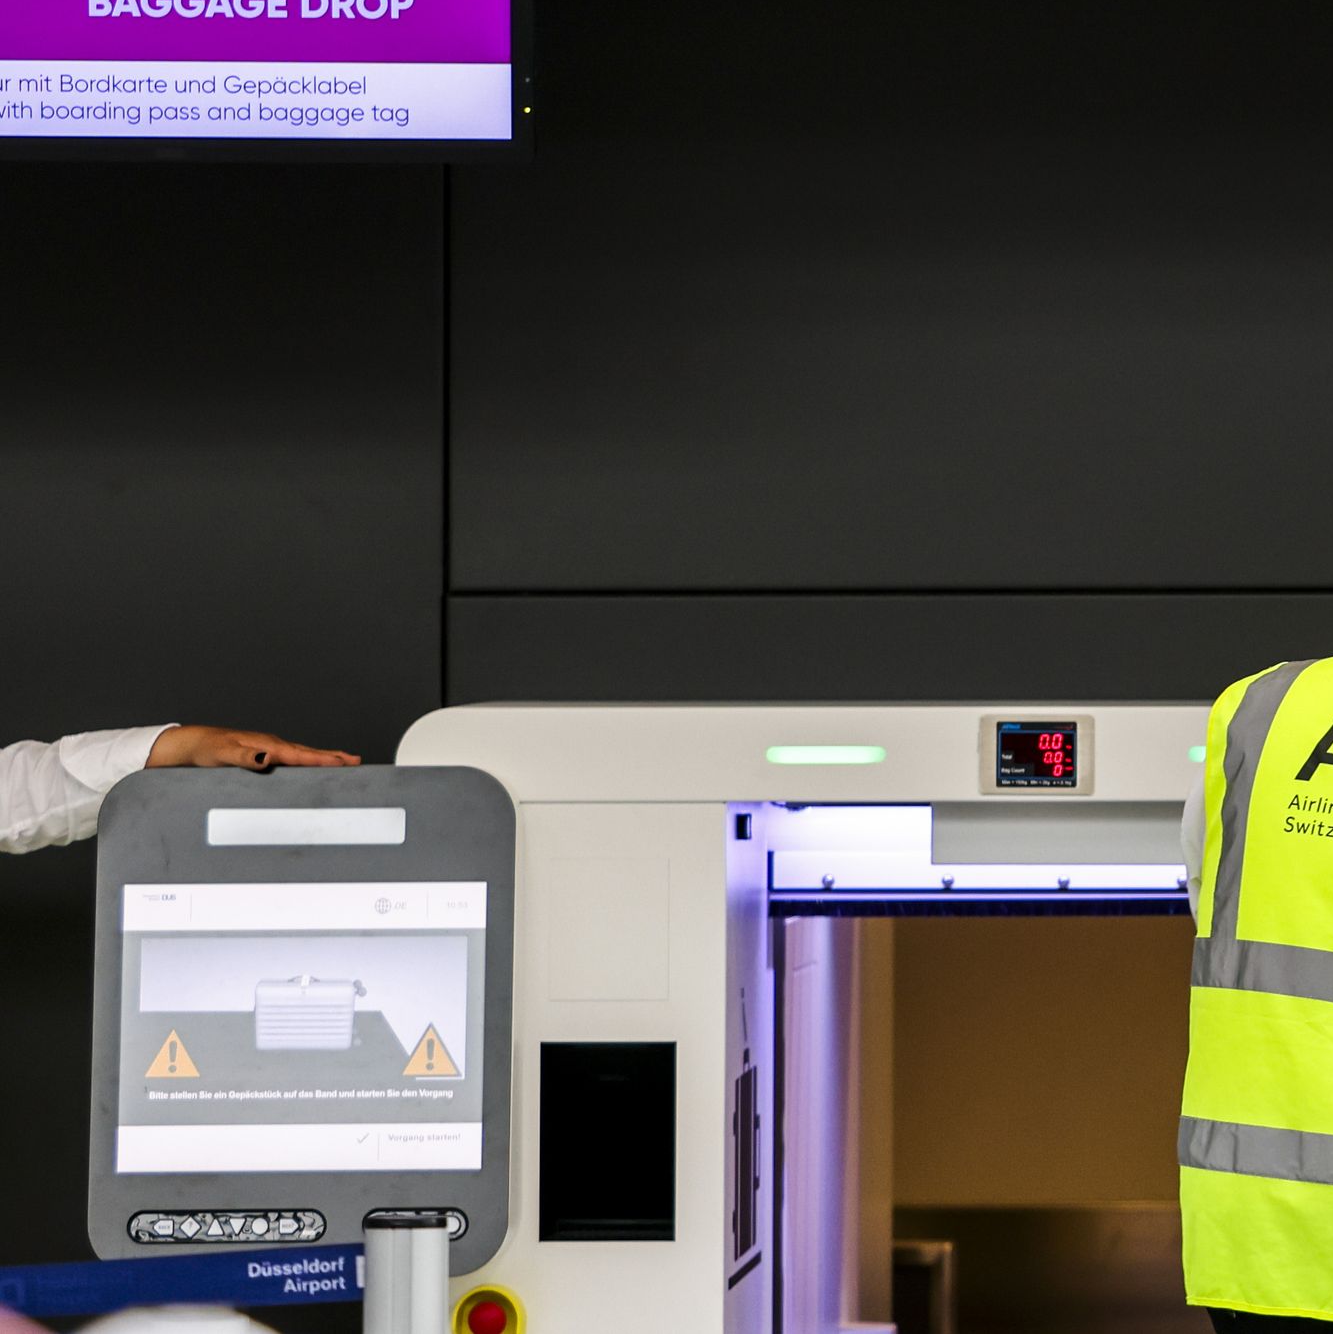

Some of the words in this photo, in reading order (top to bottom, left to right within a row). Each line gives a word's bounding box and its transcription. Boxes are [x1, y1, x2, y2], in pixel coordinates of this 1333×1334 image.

[18, 74, 52, 93] mit
[60, 75, 168, 94] Bordkarte
[175, 76, 215, 94] und
[223, 76, 367, 99] Gepäcklabel
[40, 102, 141, 125] boarding
[149, 107, 200, 125] pass
[208, 103, 251, 121] and
[259, 103, 365, 127] baggage
[372, 105, 409, 127] tag
[149, 1090, 169, 1100] Bitte
[170, 1090, 197, 1100] stellen
[199, 1090, 213, 1099] Sie
[214, 1090, 227, 1099] ein
[229, 1089, 282, 1101] Gepäckstück
[284, 1089, 298, 1099] auf
[299, 1089, 313, 1099] das
[315, 1089, 337, 1099] Band
[339, 1089, 355, 1098] und
[356, 1089, 385, 1098] starten
[387, 1088, 400, 1098] Sie
[401, 1088, 418, 1098] den
[419, 1088, 454, 1100] Vorgang
[388, 1133, 424, 1143] Vorgang
[247, 1256, 345, 1280] Düsseldorf
[283, 1274, 346, 1294] Airport
